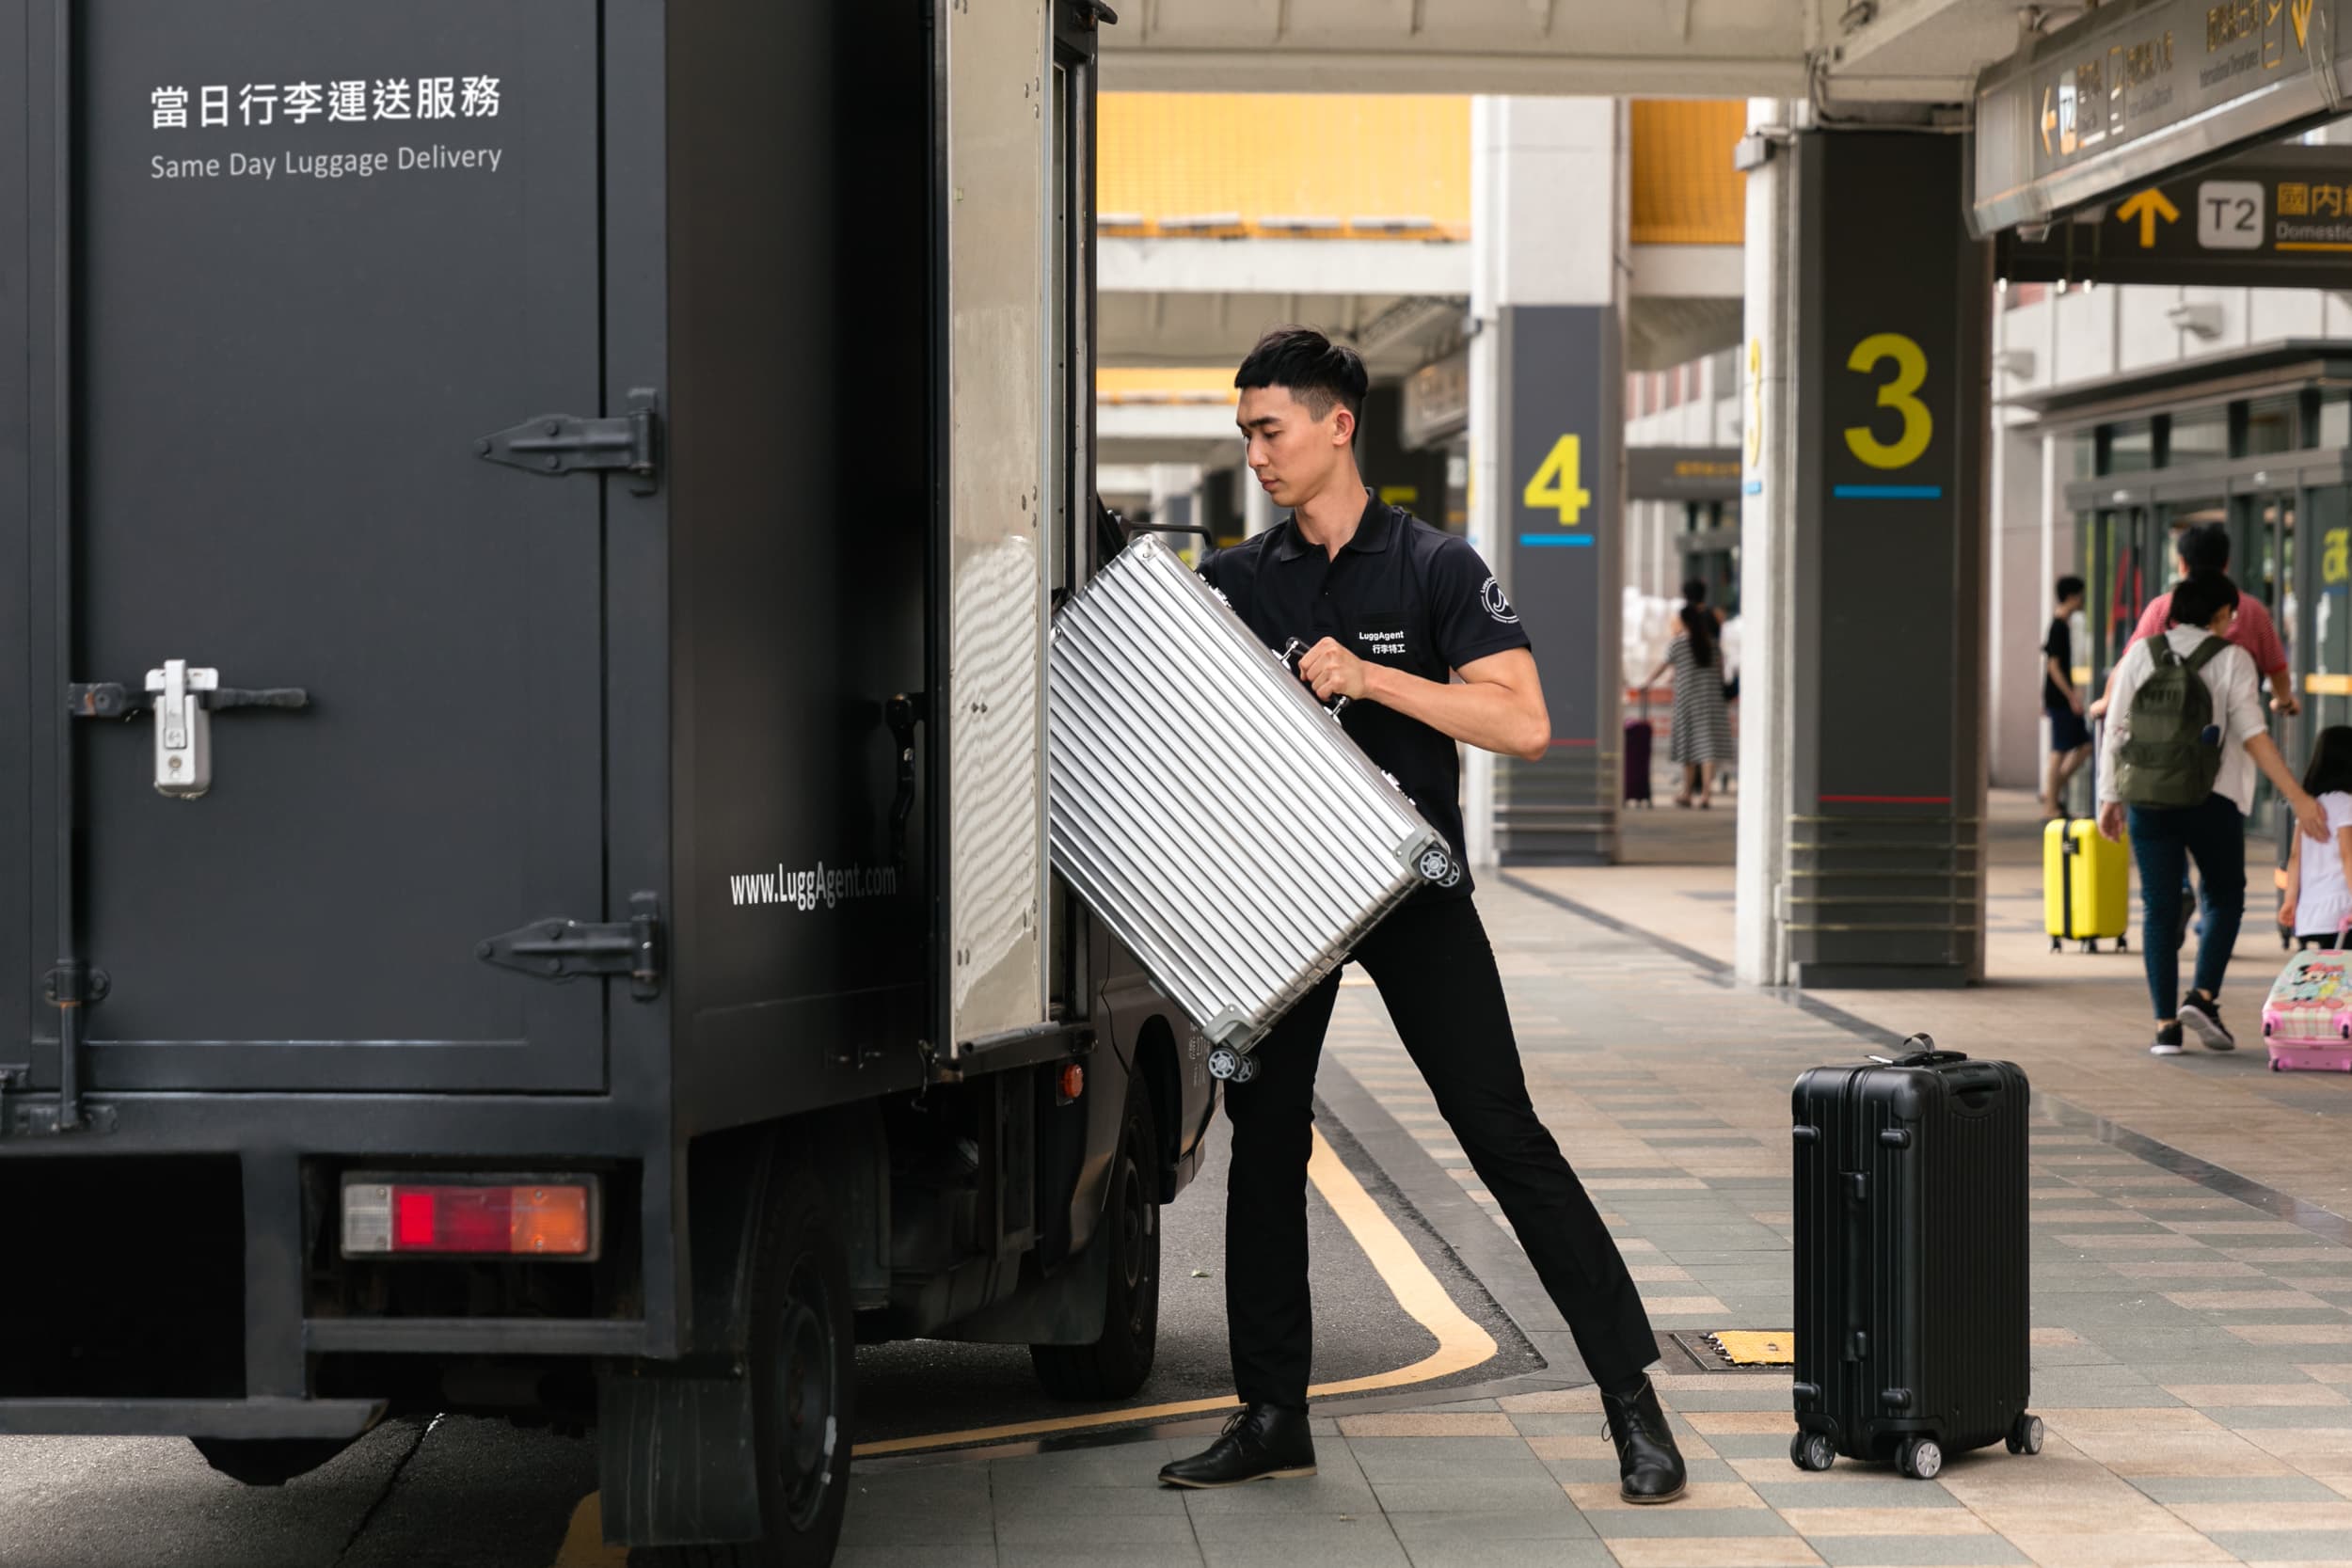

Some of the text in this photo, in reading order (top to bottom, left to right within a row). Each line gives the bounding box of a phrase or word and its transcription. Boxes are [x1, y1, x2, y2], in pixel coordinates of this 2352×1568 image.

[151, 74, 501, 130] 當日行李運送服務
[151, 144, 502, 181] Same Day Luggage Delivery
[2206, 198, 2257, 232] T2
[2277, 182, 2352, 217] 國內
[1843, 332, 1933, 469] 3
[1523, 434, 1591, 526] 4
[1359, 630, 1405, 641] LuggAgent
[730, 861, 897, 911] www.LuggAgent.com
